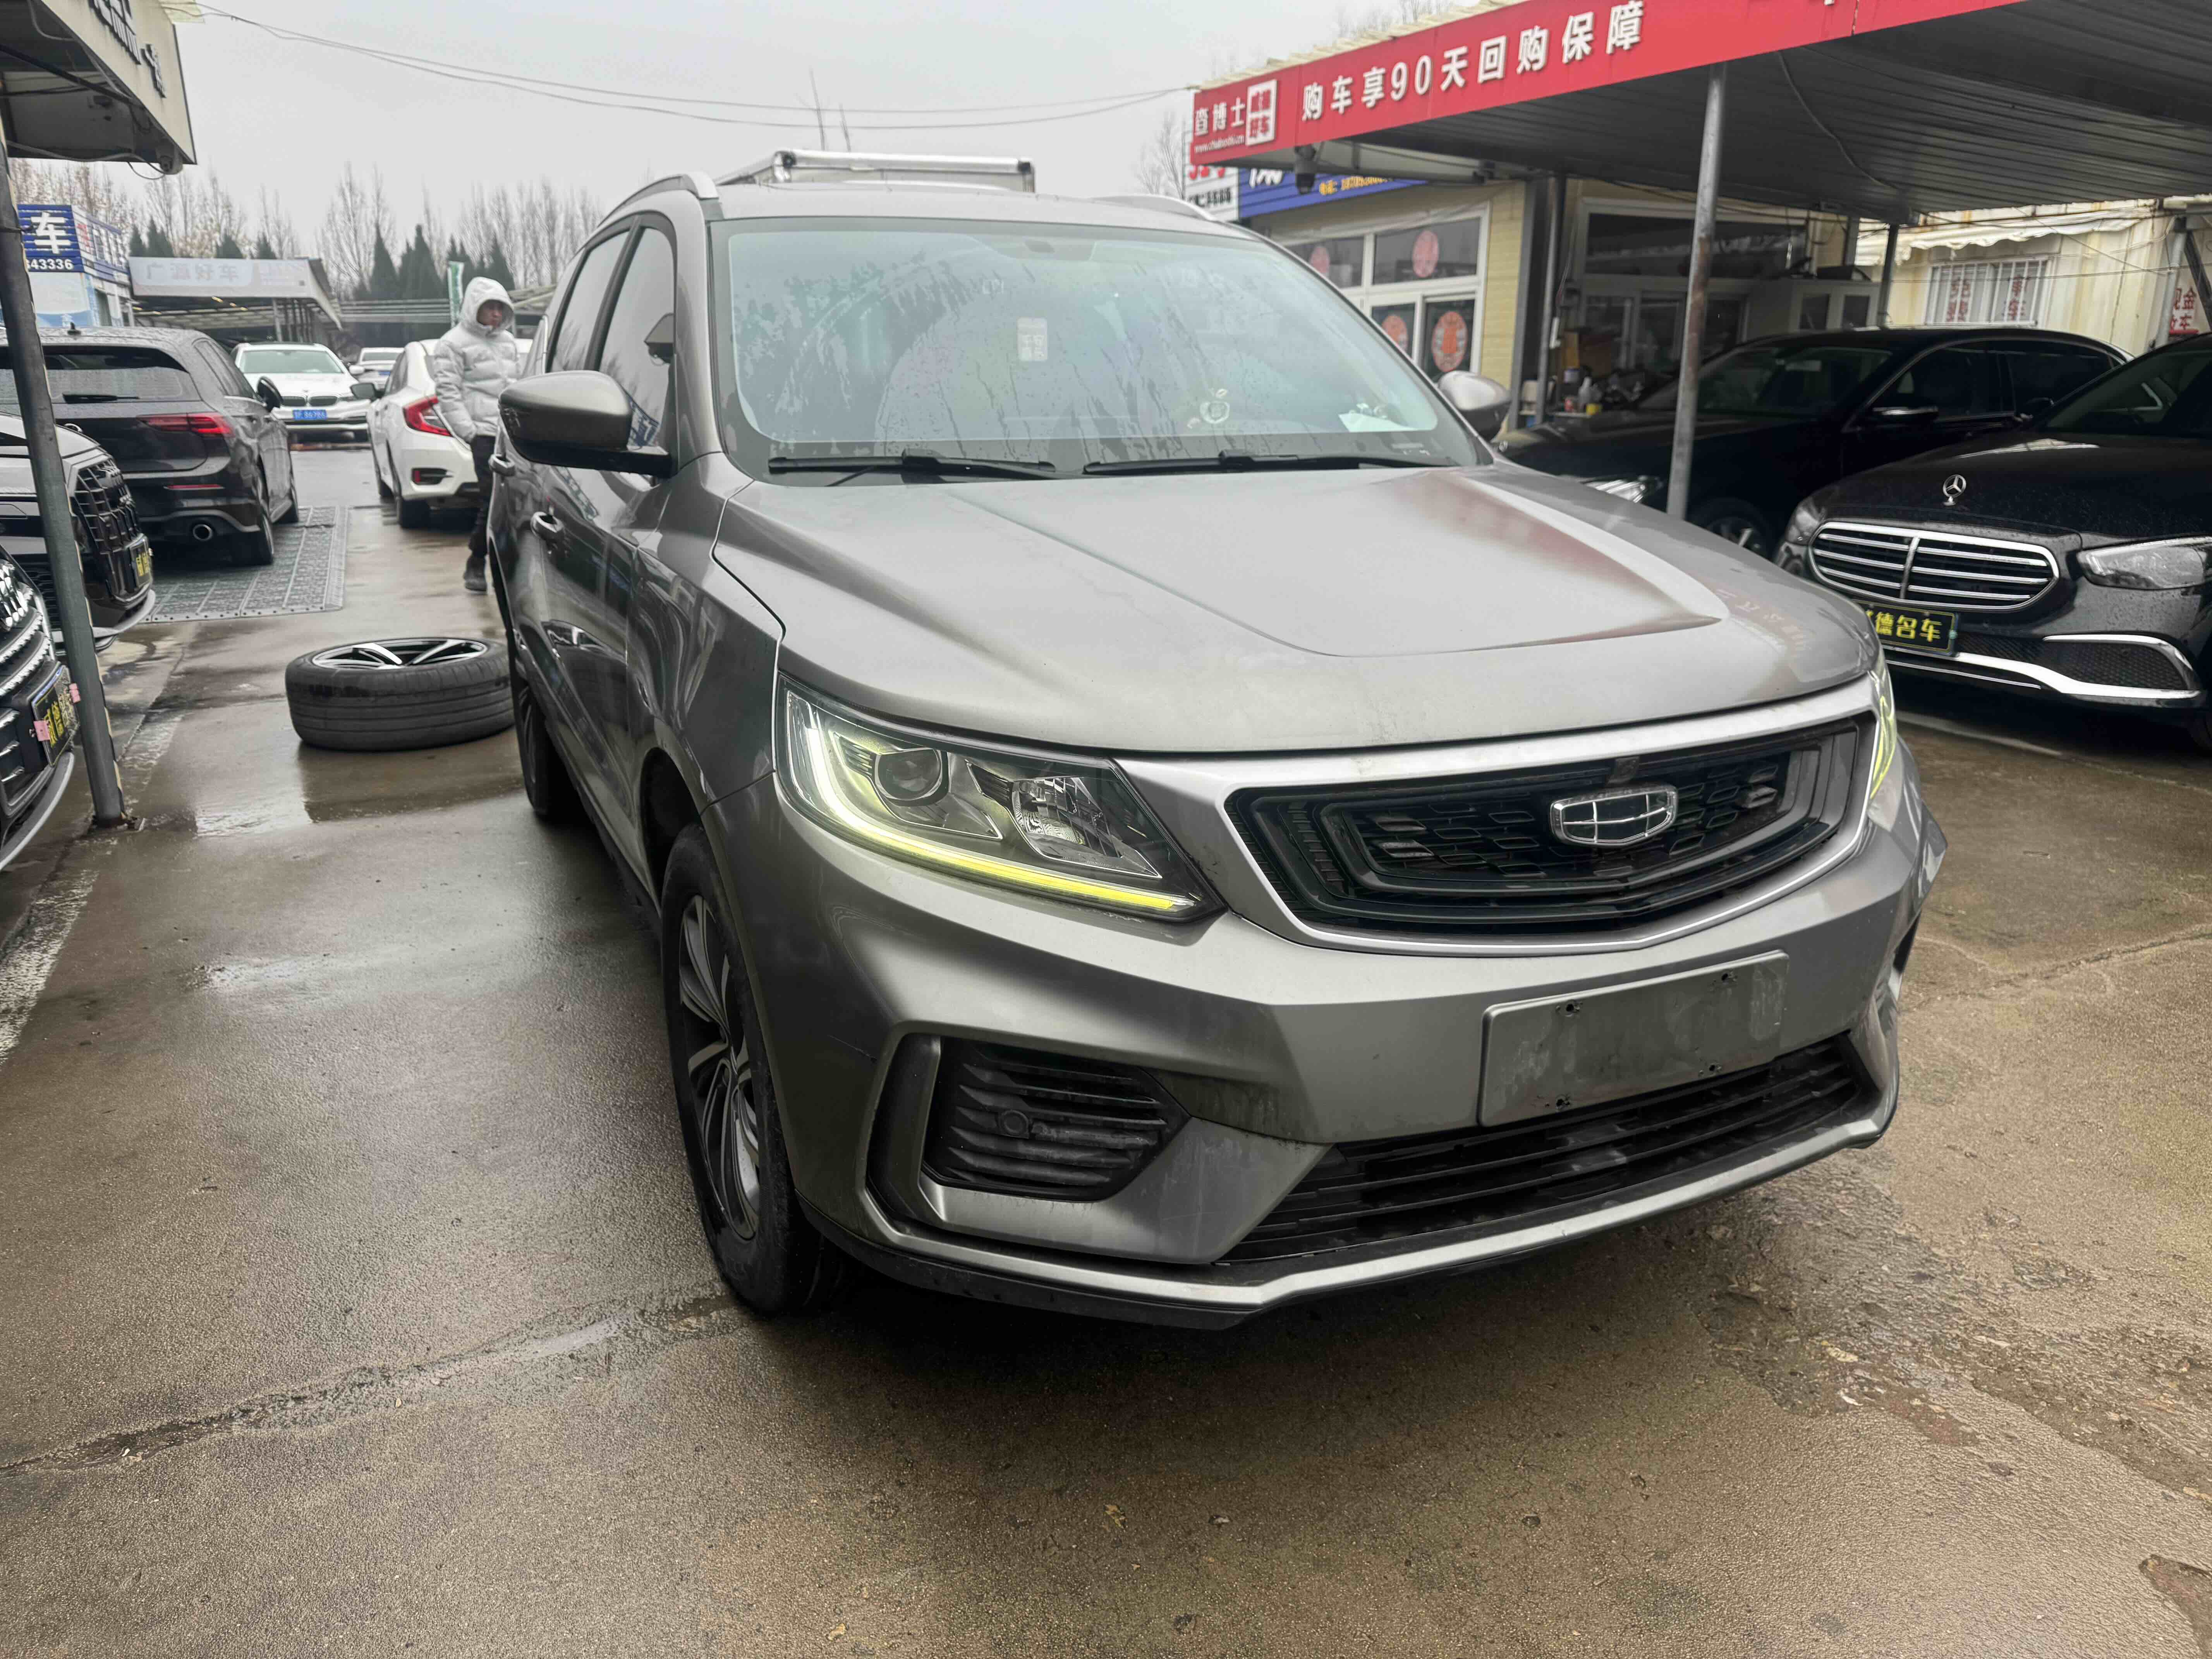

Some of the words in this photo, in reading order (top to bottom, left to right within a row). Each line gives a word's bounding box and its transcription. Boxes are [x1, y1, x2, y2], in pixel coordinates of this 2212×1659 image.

[1302, 0, 1644, 121] 购车享90天回购保障
[31, 212, 71, 254] 车
[1865, 609, 1942, 642] 德名车
